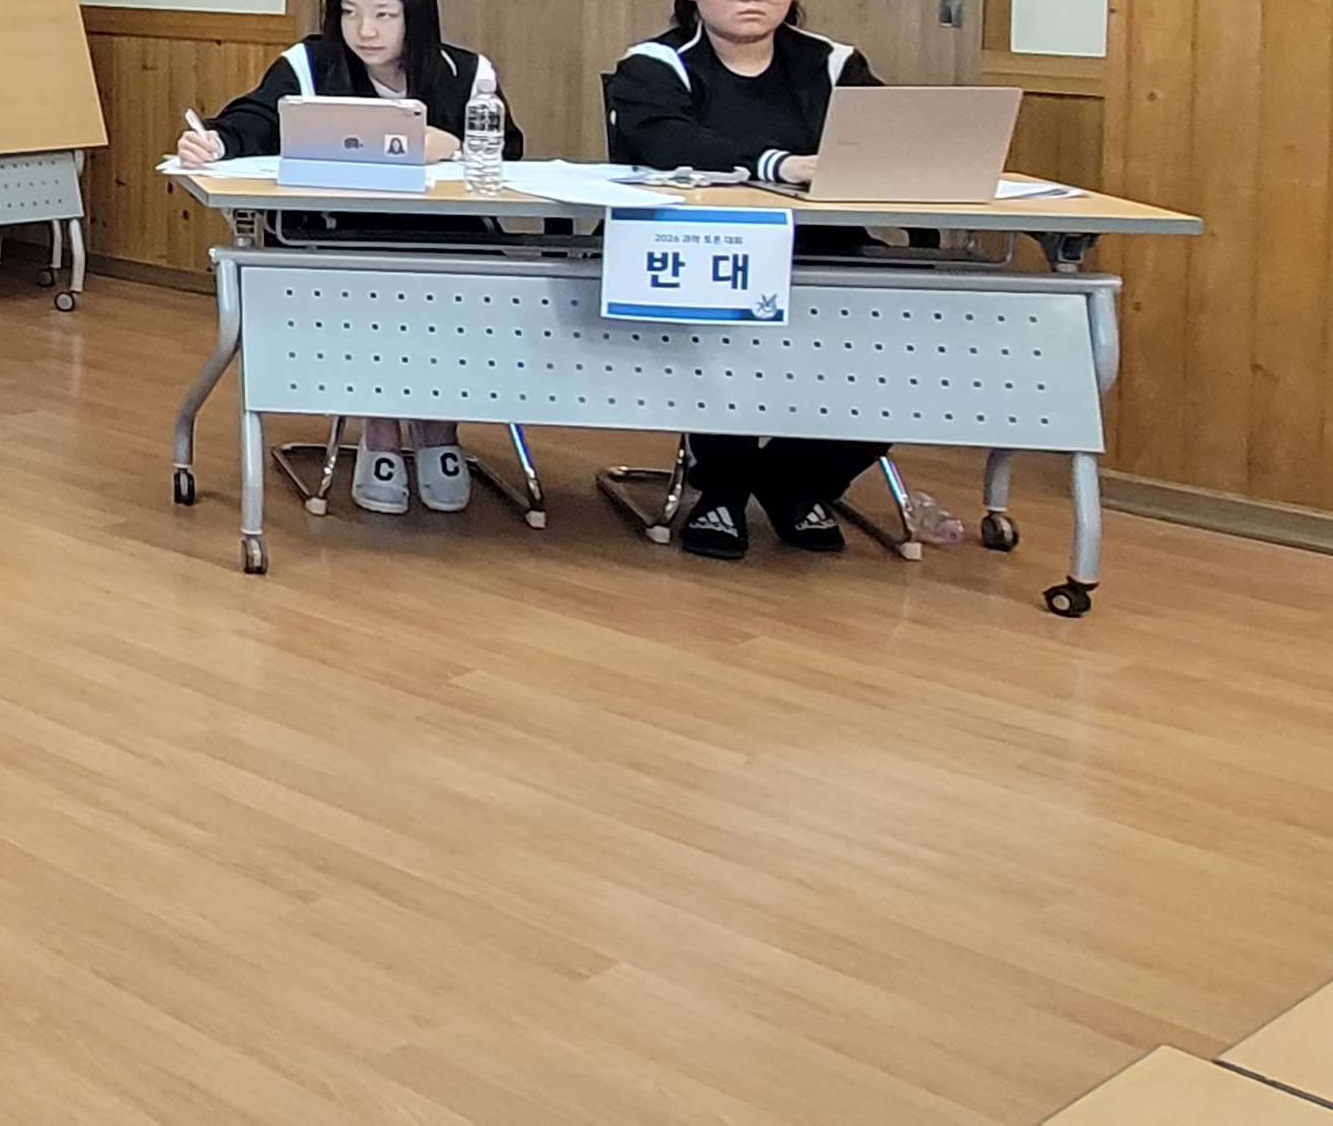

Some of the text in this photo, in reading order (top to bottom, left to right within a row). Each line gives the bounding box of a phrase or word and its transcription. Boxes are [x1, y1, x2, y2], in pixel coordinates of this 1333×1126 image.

[654, 234, 680, 243] 2026
[646, 251, 749, 290] 반 대
[375, 457, 395, 481] C
[440, 452, 460, 476] C
